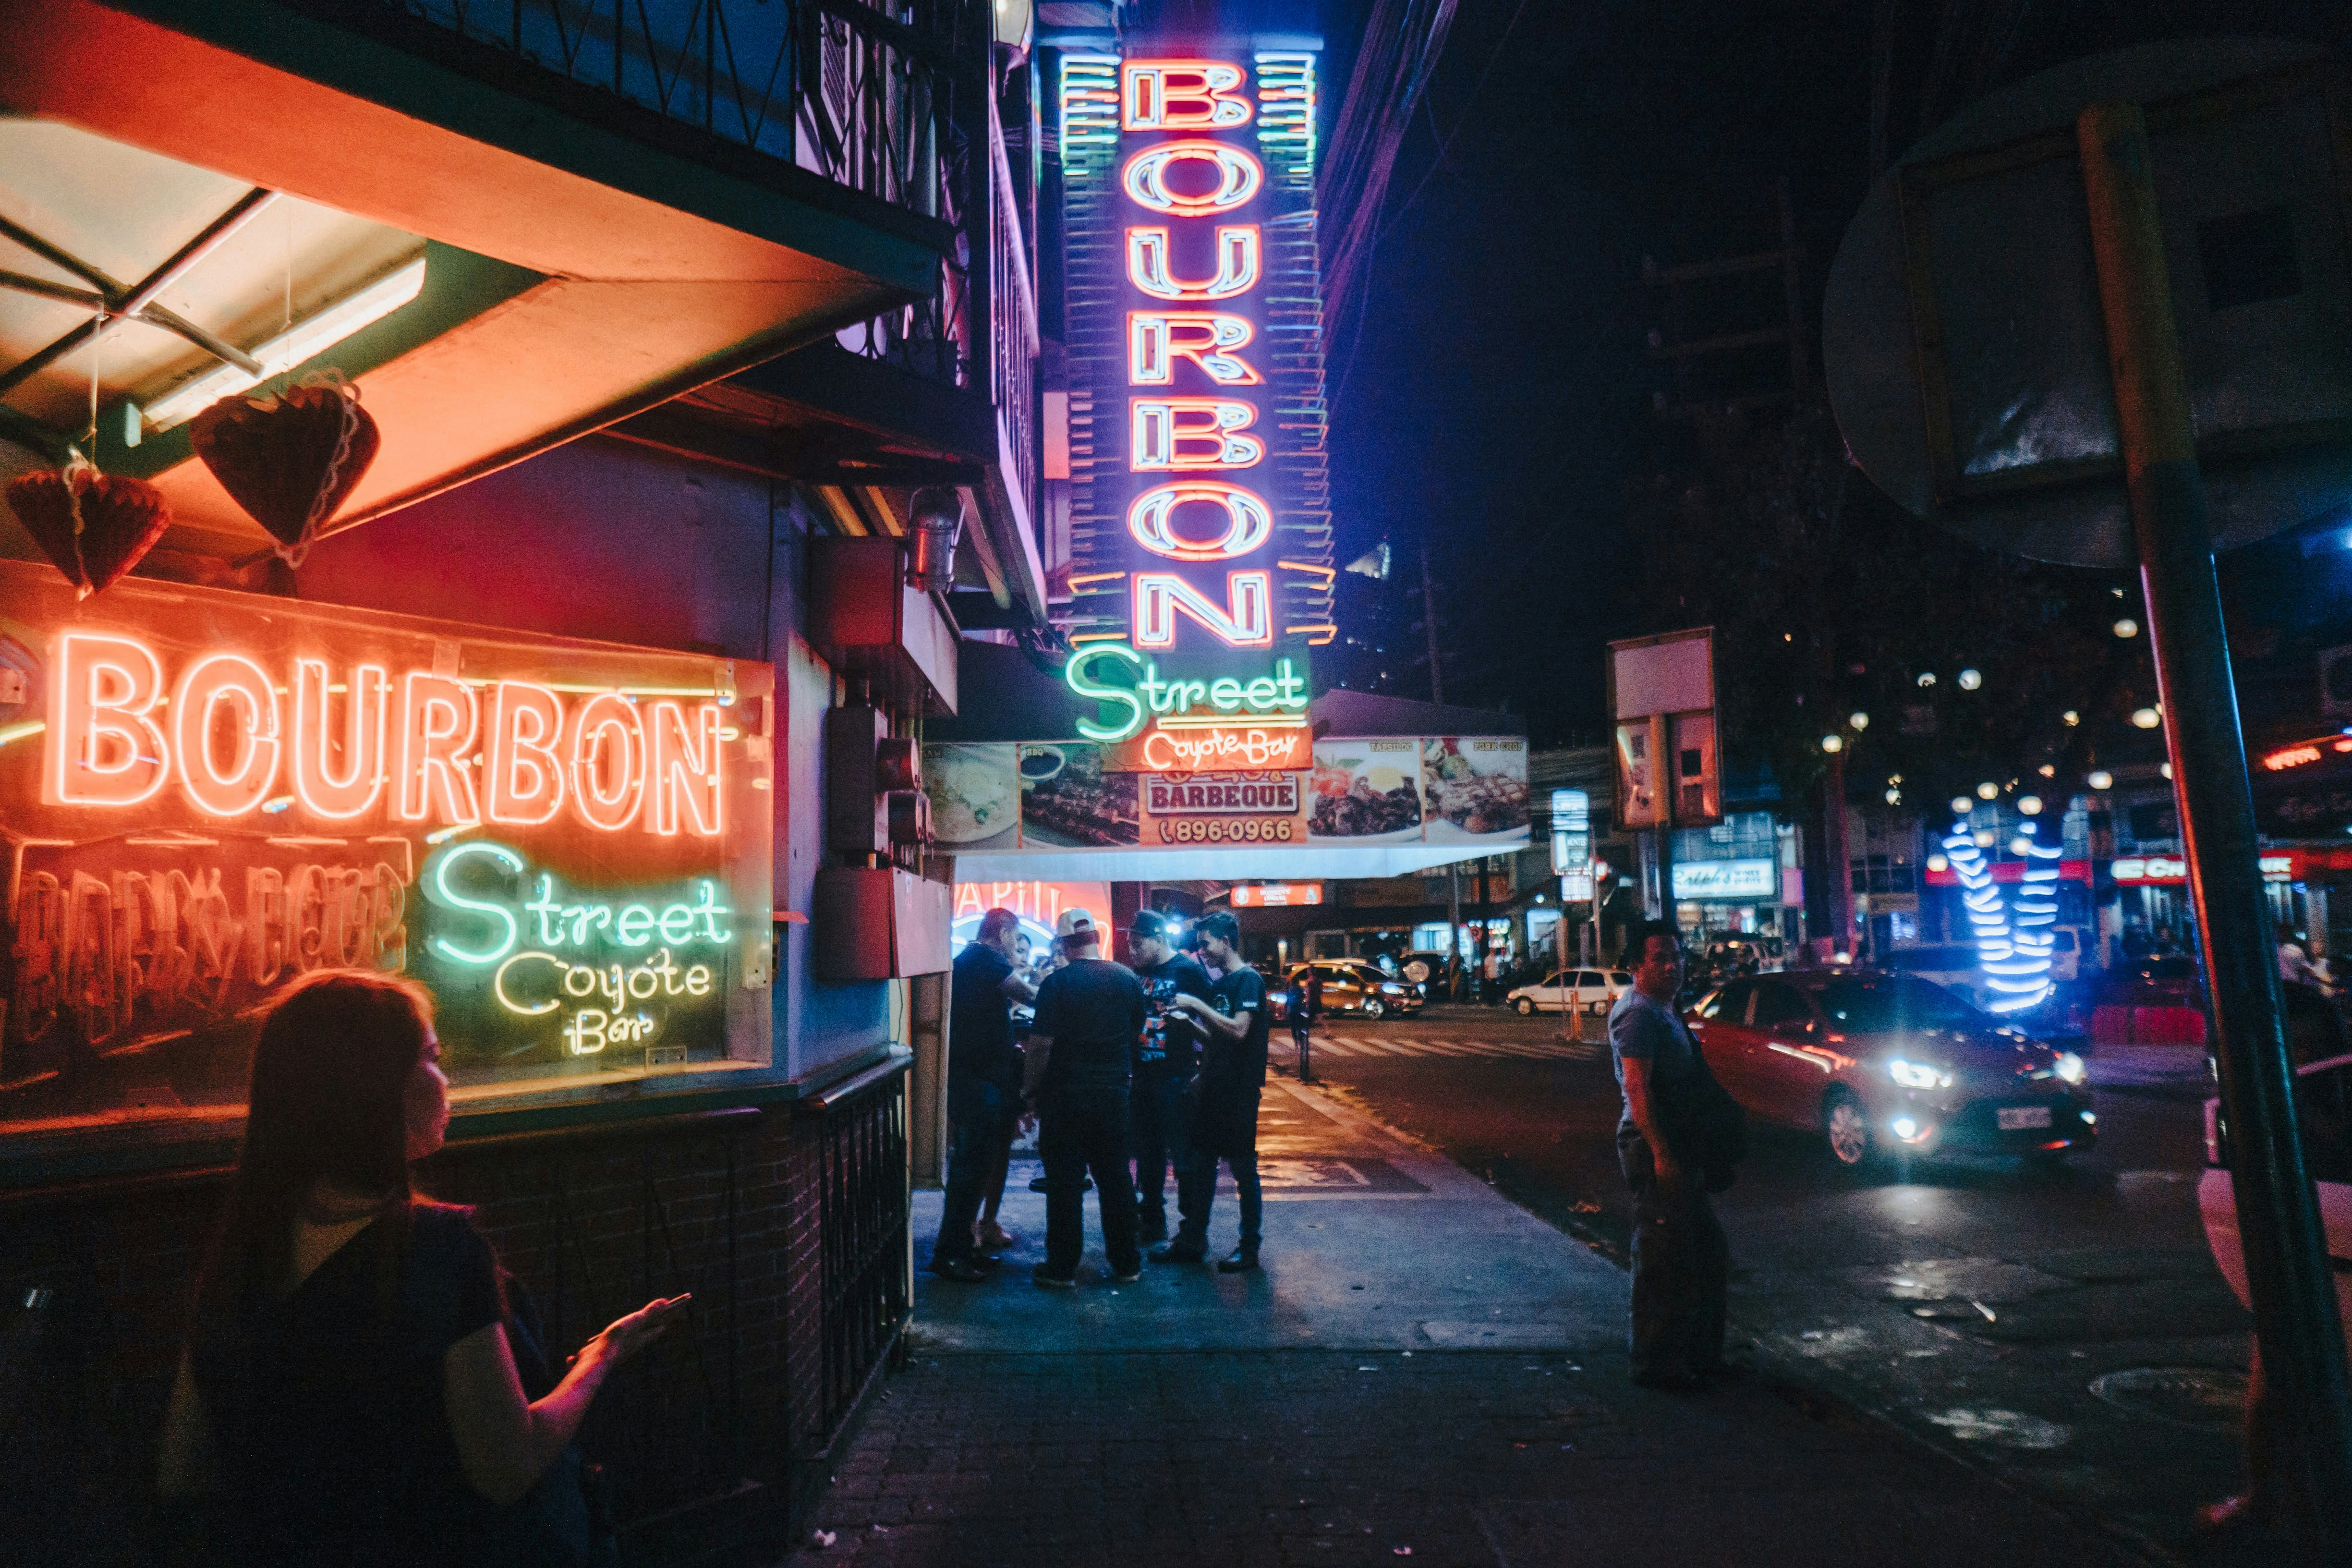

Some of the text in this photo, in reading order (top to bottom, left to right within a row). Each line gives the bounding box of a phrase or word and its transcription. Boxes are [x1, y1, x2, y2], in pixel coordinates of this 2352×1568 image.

[1121, 59, 1274, 650] BOURBON
[1065, 644, 1309, 740] Street
[52, 633, 723, 836] BOURBON
[1026, 748, 1044, 756] BBQ
[1144, 729, 1298, 769] Coyote Bar
[1151, 785, 1294, 809] BARBEQUE
[1176, 820, 1291, 842] 896-0966
[436, 841, 732, 964] Street
[495, 947, 711, 1015] Coyote
[563, 1009, 655, 1055] Bar
